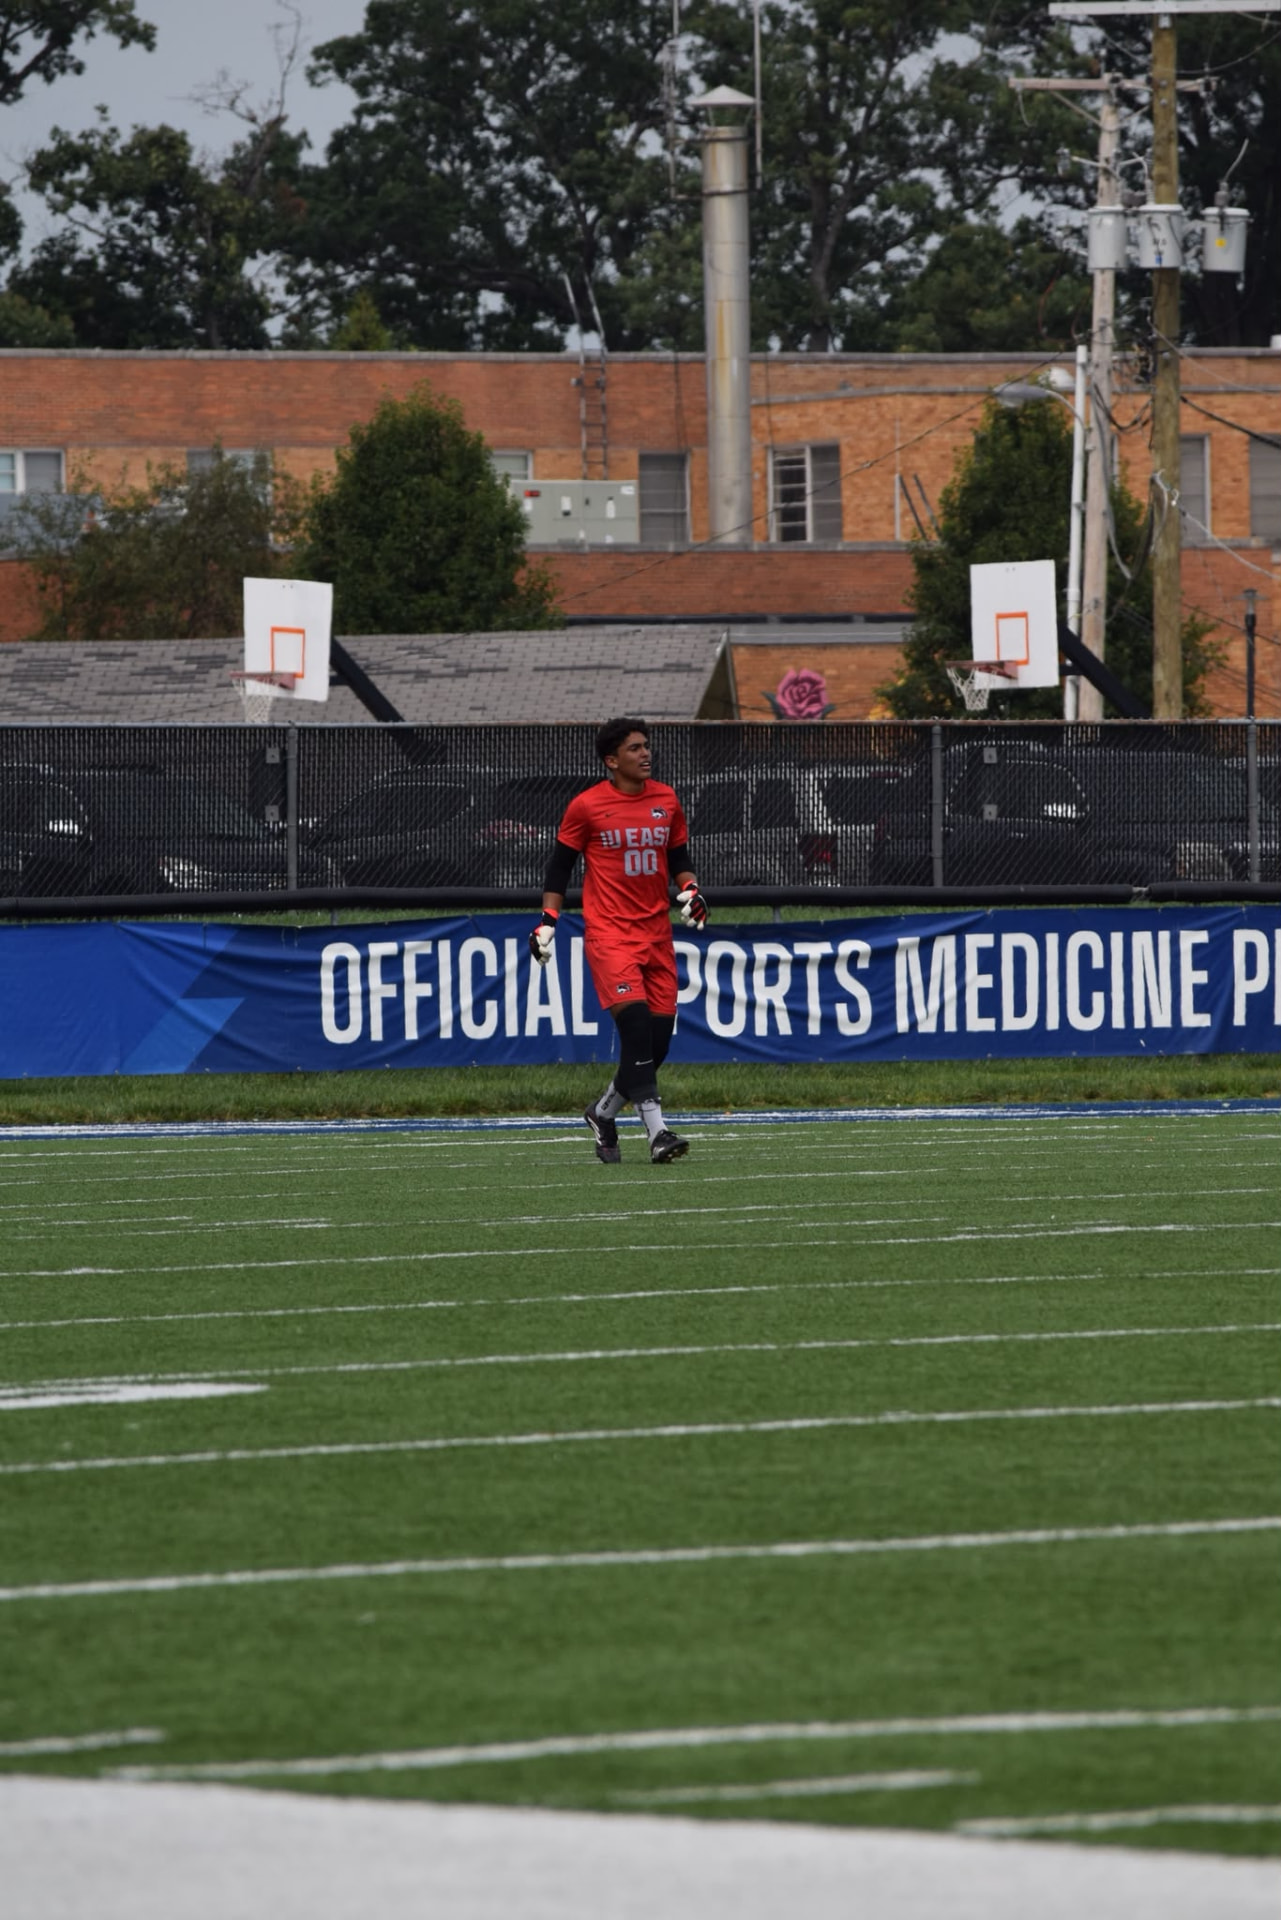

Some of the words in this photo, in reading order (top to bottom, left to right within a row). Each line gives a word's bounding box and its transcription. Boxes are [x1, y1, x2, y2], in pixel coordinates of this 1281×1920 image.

[624, 849, 658, 876] 00
[320, 937, 598, 1044] OFFICIAL
[672, 940, 872, 1038] PORTS
[895, 930, 1211, 1033] MEDICINE
